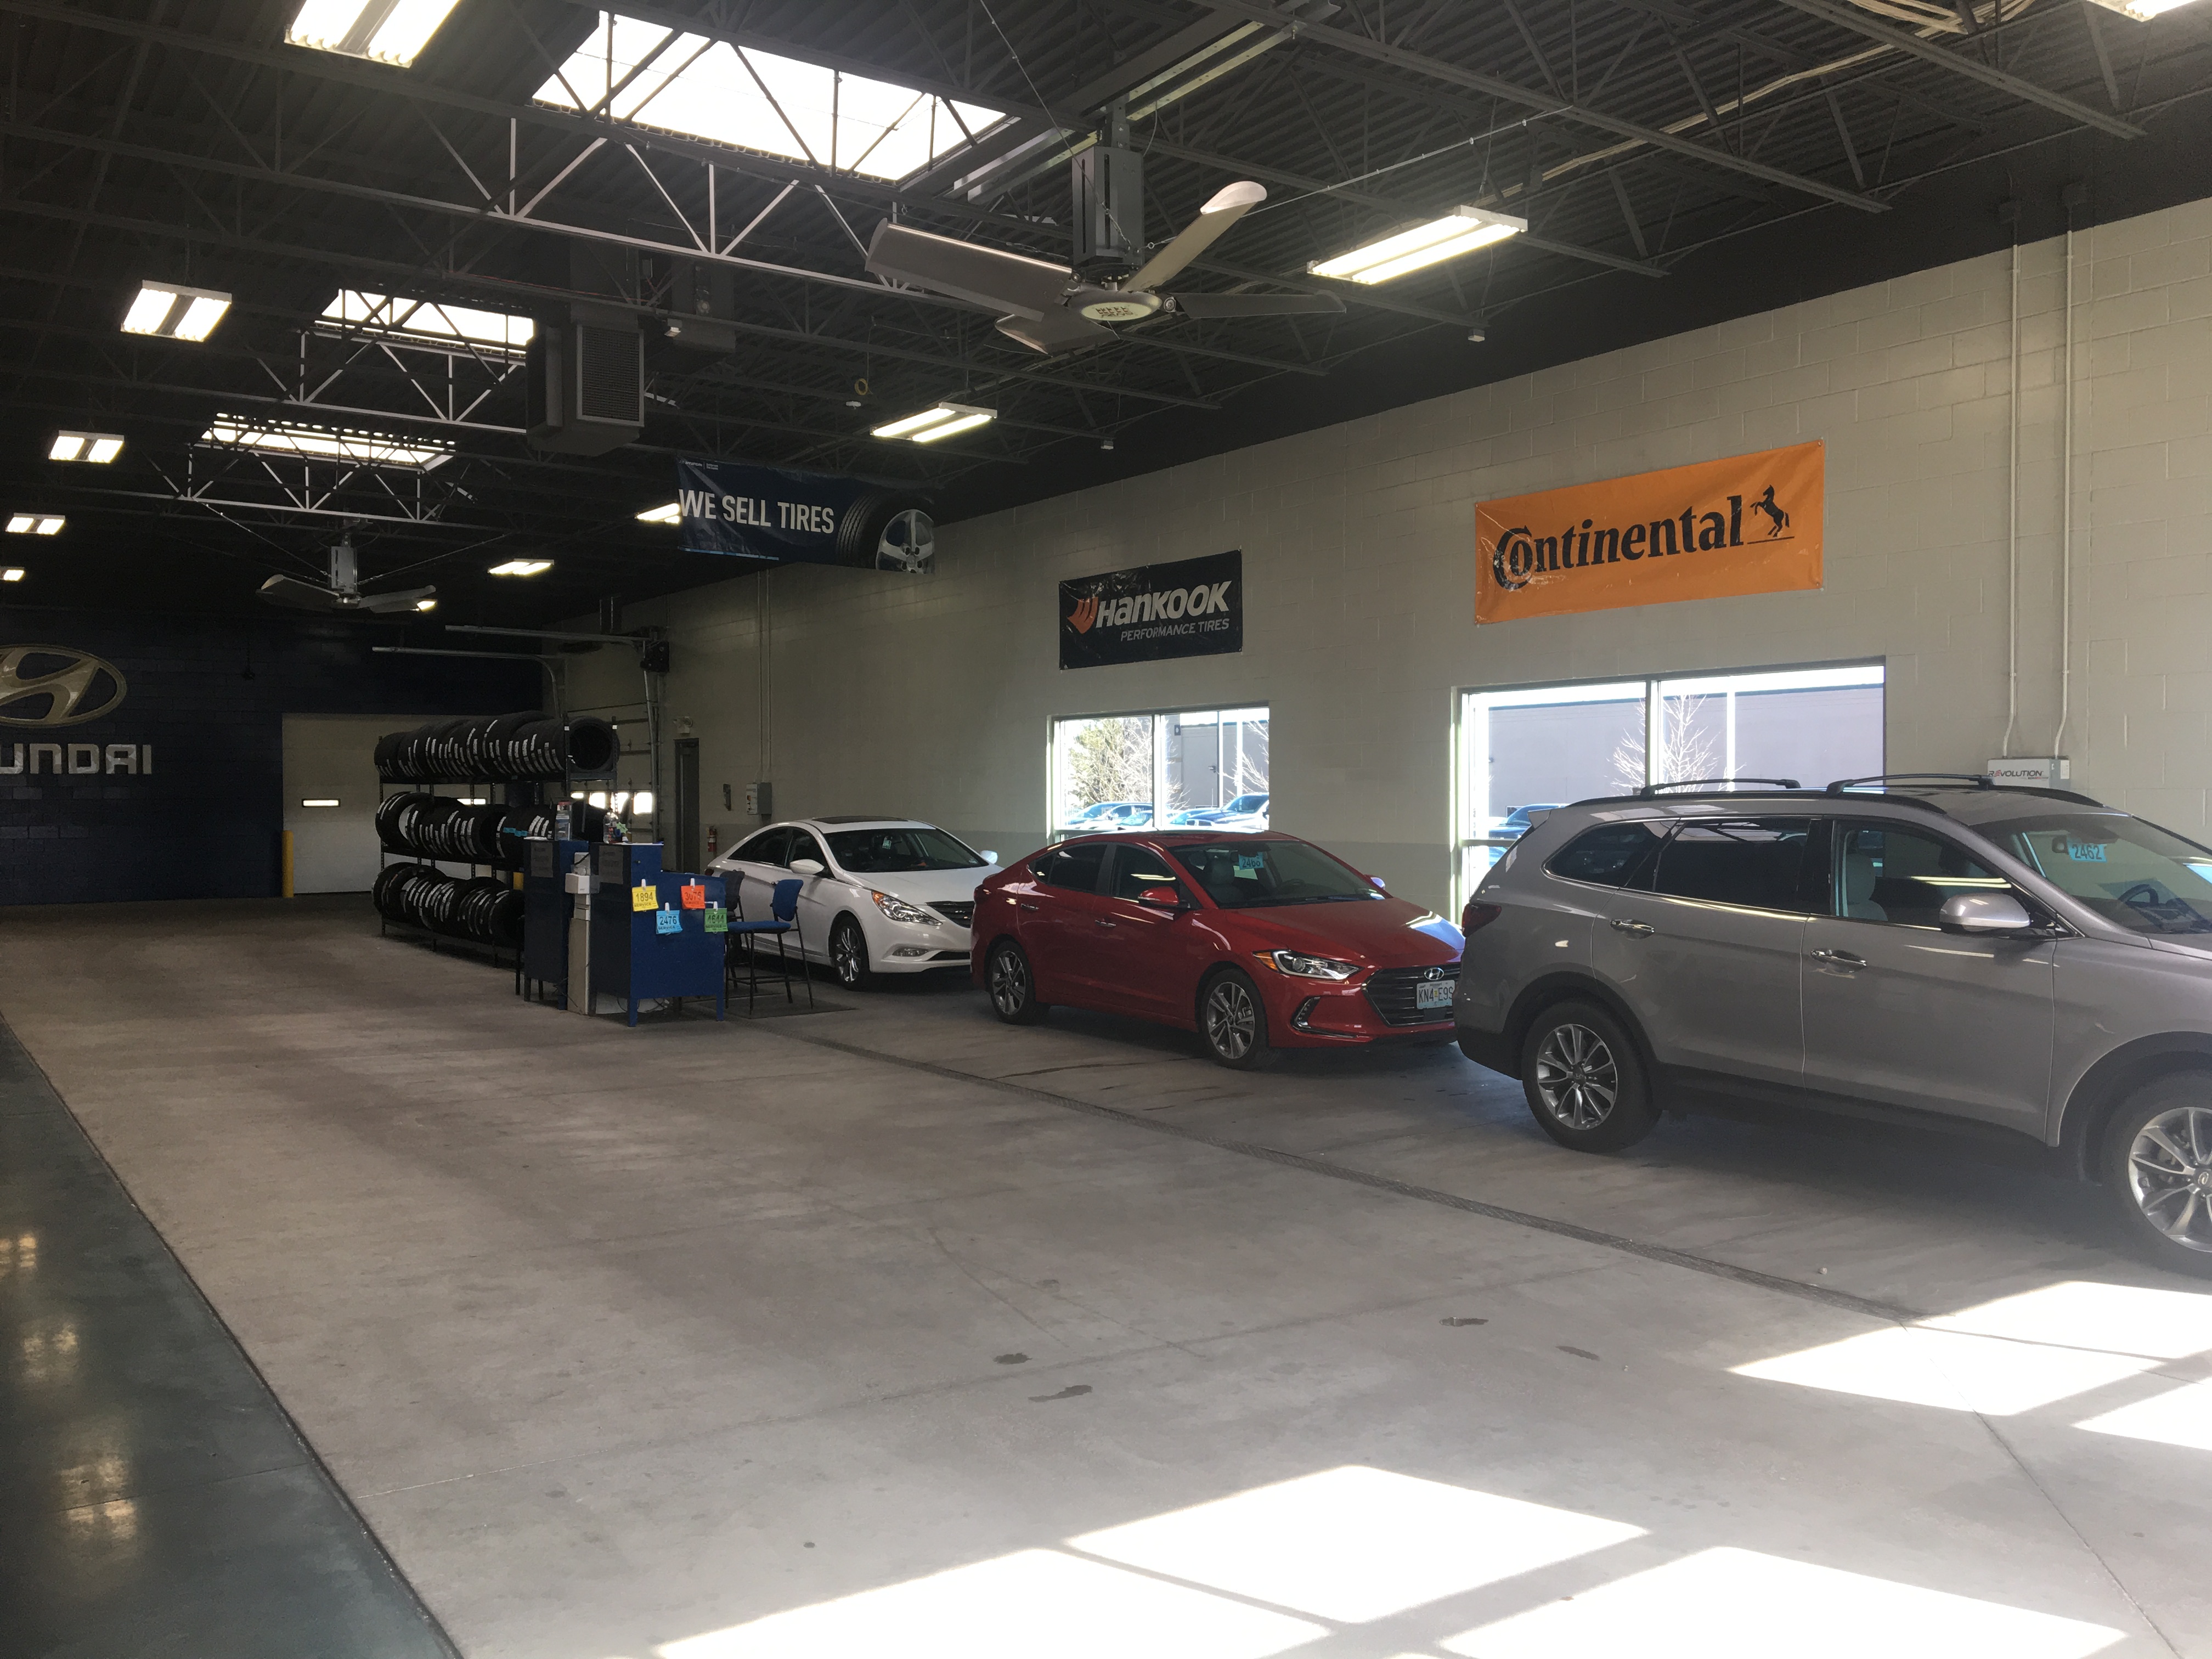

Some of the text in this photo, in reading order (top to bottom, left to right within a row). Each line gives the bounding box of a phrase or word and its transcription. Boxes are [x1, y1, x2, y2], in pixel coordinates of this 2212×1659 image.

[679, 489, 834, 534] WE SELL TIRES
[1492, 495, 1743, 590] Continental
[1120, 618, 1230, 642] PERFORMANCE TIRES
[2072, 844, 2103, 860] 2462
[635, 891, 654, 902] 1894
[659, 915, 678, 926] 2476
[1419, 988, 1434, 1003] KN4
